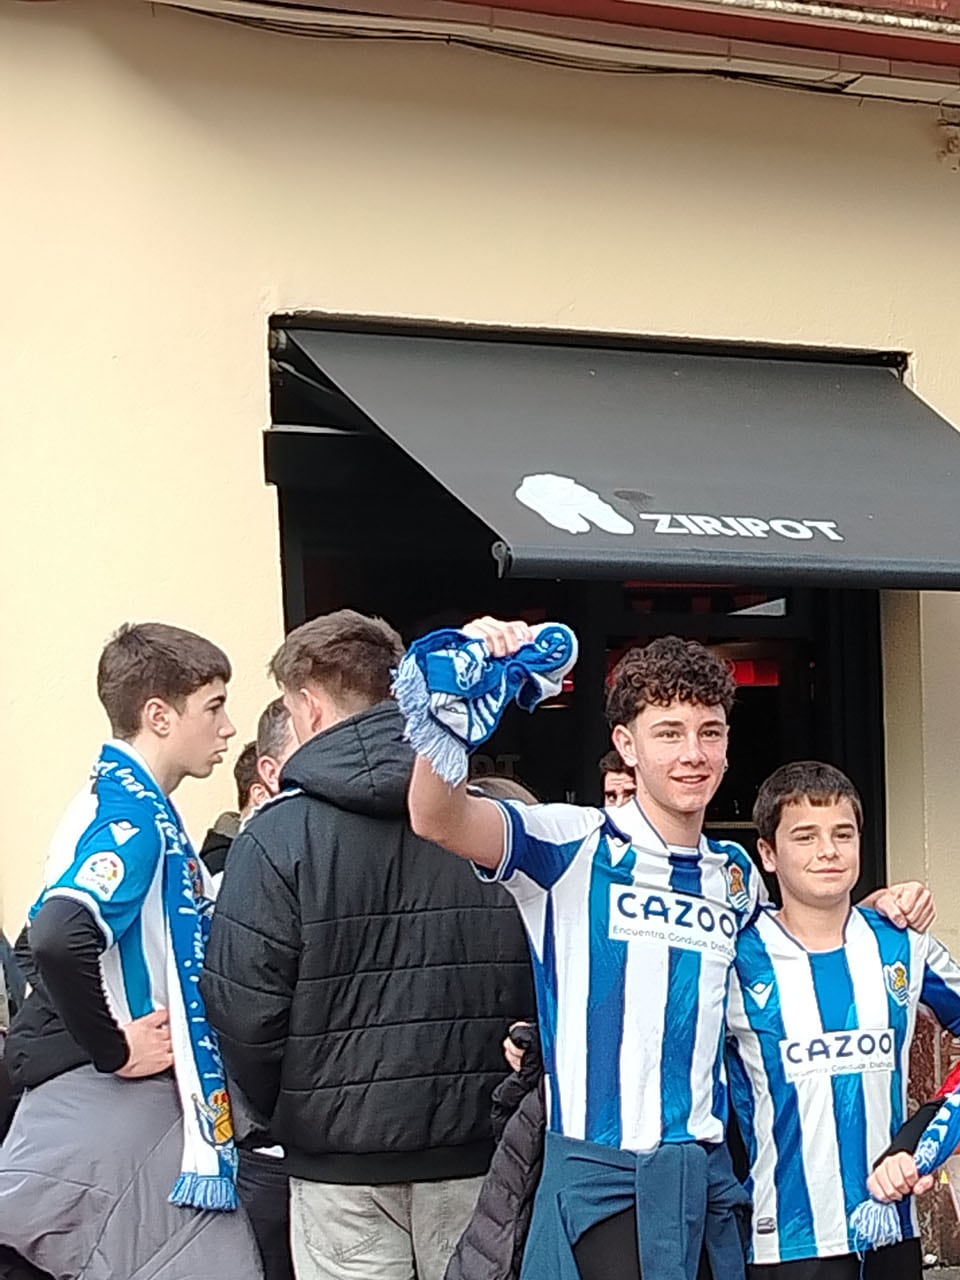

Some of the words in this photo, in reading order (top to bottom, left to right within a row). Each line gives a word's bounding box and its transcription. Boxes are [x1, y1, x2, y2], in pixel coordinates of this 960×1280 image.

[638, 513, 845, 541] ZIRIPOT
[617, 892, 736, 940] CAZOO
[786, 1033, 892, 1064] CAZOO
